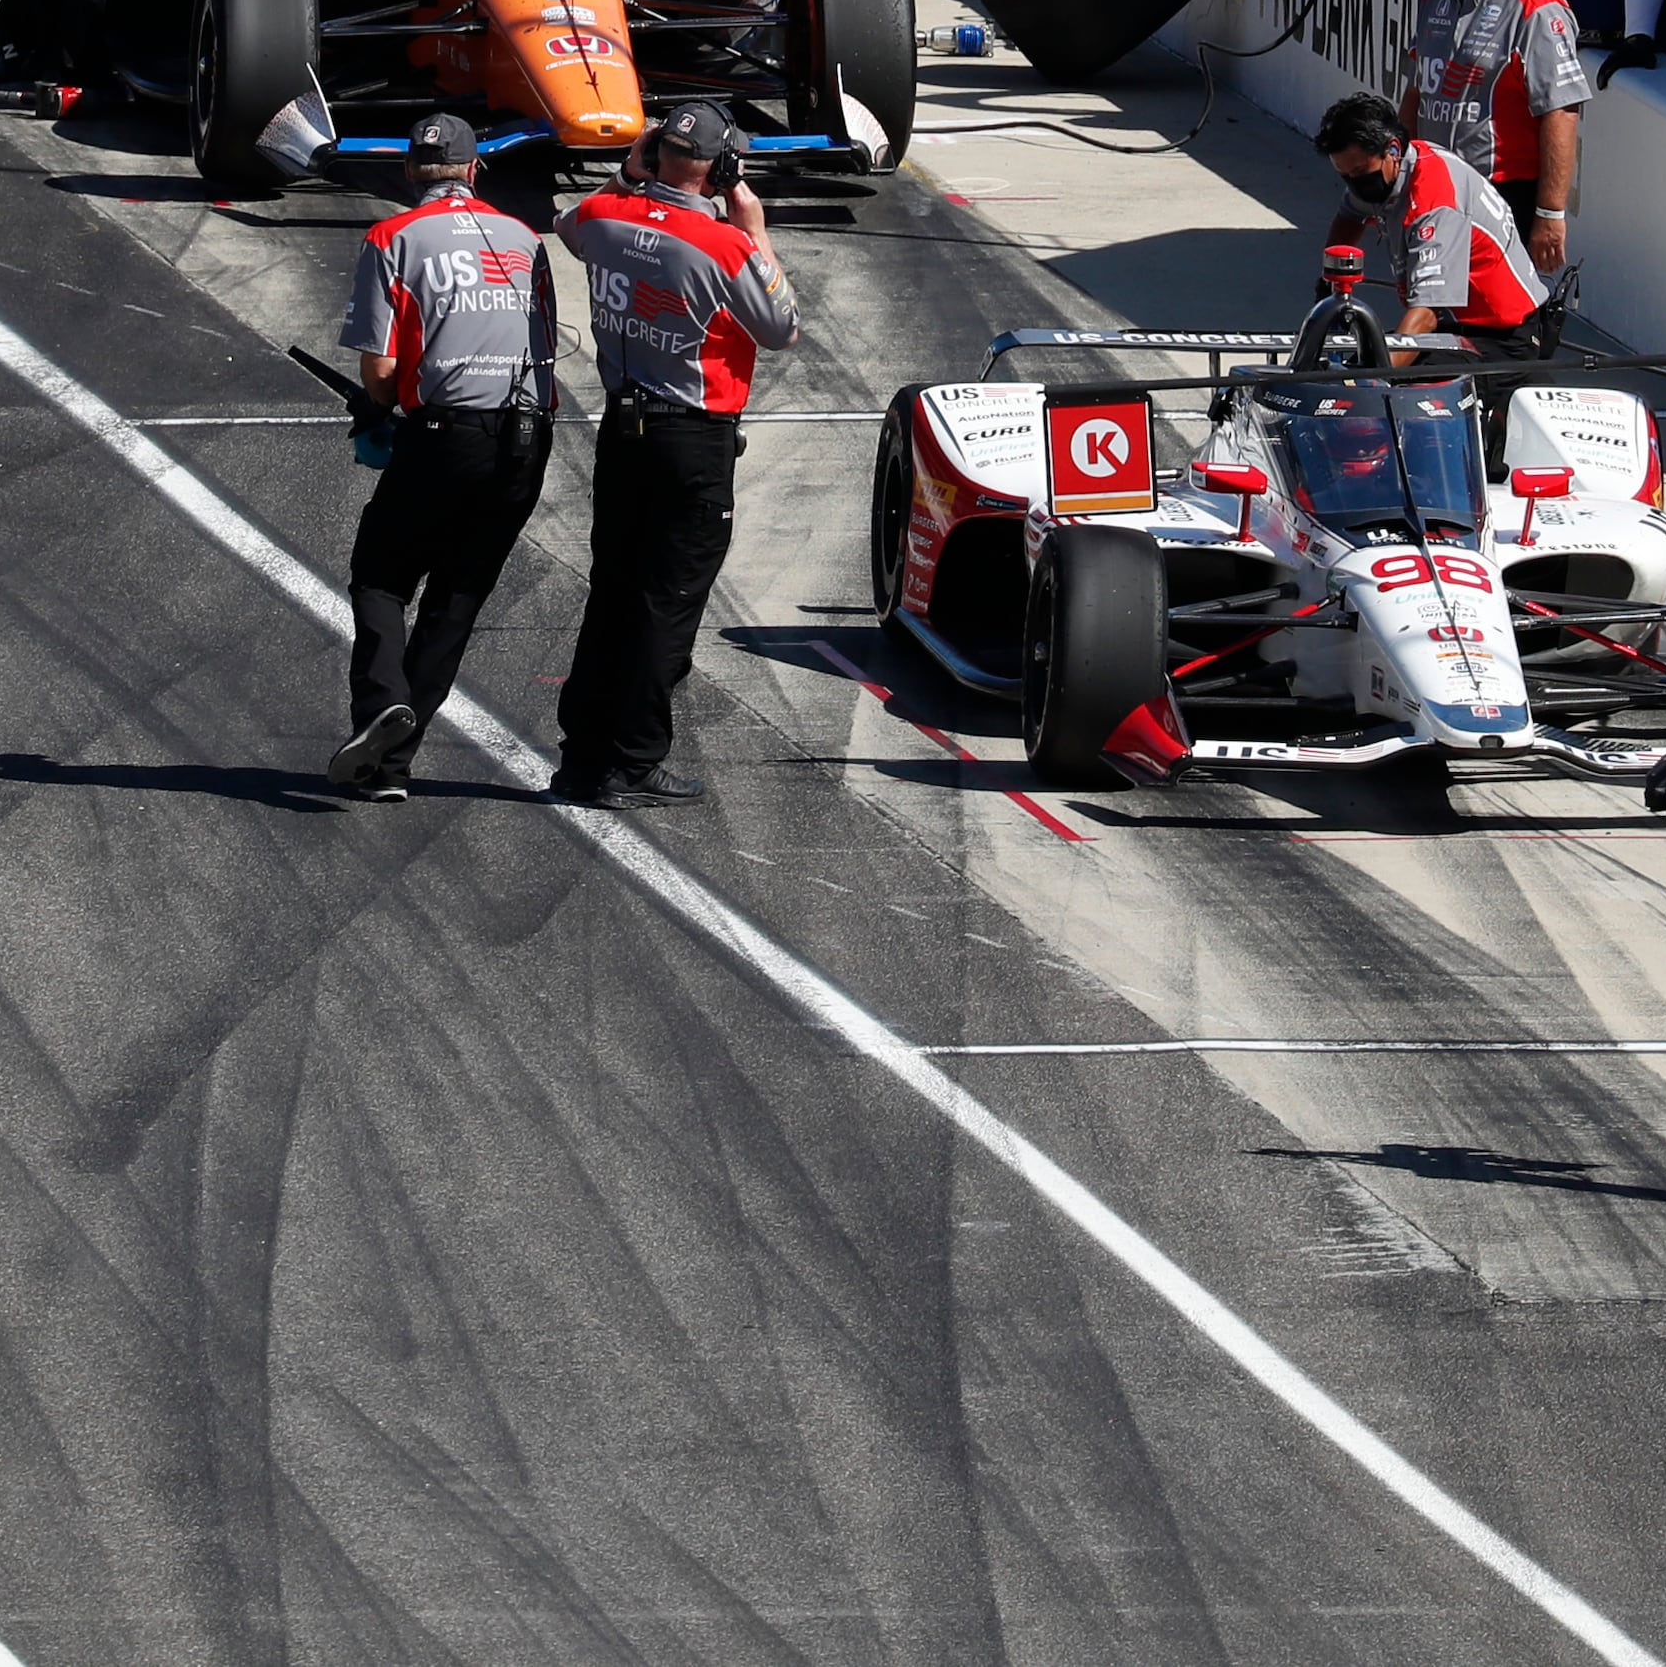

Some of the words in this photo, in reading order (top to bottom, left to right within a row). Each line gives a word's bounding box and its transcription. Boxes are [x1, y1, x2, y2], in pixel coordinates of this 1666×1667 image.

[1418, 99, 1481, 125] ONCRETE
[452, 227, 493, 235] HONDA
[623, 246, 662, 266] HONDA
[423, 249, 479, 294] US
[591, 262, 630, 312] US
[435, 289, 537, 319] CONCRETE
[591, 304, 686, 355] CONCRETE
[940, 387, 979, 402] US
[1535, 390, 1574, 403] US
[944, 397, 1032, 411] CONCRETE
[1319, 399, 1337, 410] US
[1538, 401, 1626, 417] CONCRETE
[958, 411, 1035, 424] AutoNation
[1550, 414, 1626, 431] AutoNation
[963, 426, 1033, 442] CURB
[1560, 430, 1629, 448] CURB
[969, 441, 1035, 458] UniFirst
[1086, 431, 1127, 466] K
[1568, 446, 1633, 463] UniFirst
[1371, 554, 1493, 595] 98
[1216, 744, 1289, 758] US
